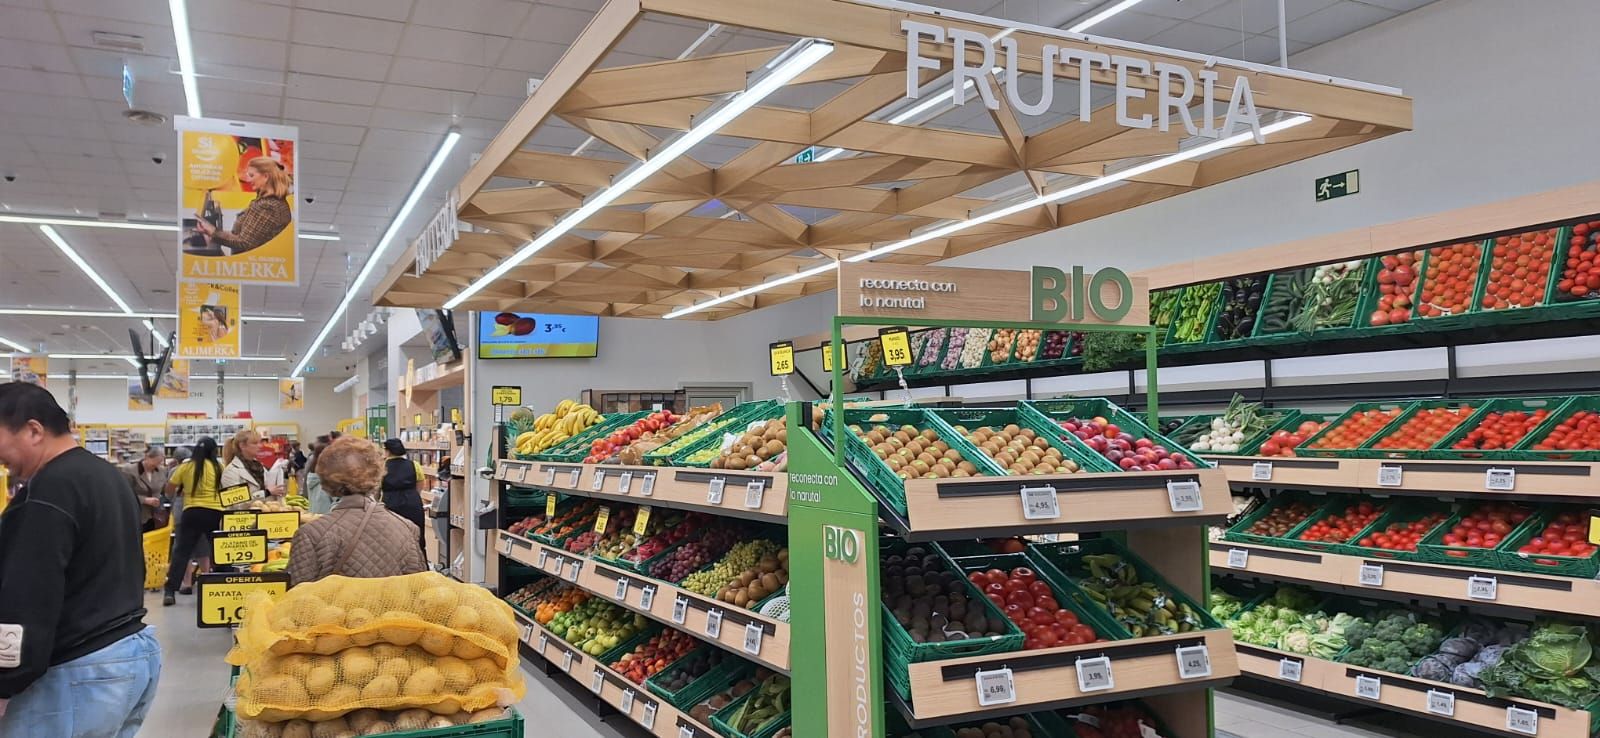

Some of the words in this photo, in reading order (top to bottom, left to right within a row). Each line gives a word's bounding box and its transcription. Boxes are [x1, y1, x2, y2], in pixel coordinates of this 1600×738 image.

[901, 19, 1266, 145] FRUTERÍA
[190, 260, 289, 279] ALIMERKA
[859, 277, 929, 292] reconecta
[930, 281, 957, 293] con
[859, 293, 873, 307] lo
[1030, 264, 1134, 323] BIO
[183, 346, 235, 356] ALIMERKA
[888, 348, 905, 361] 3,95
[776, 360, 789, 371] 2,65
[789, 473, 823, 485] reconecta
[824, 475, 838, 486] con
[789, 489, 796, 500] lo
[824, 526, 859, 564] BIO
[225, 551, 254, 562] 1,29
[208, 590, 243, 598] PATATA
